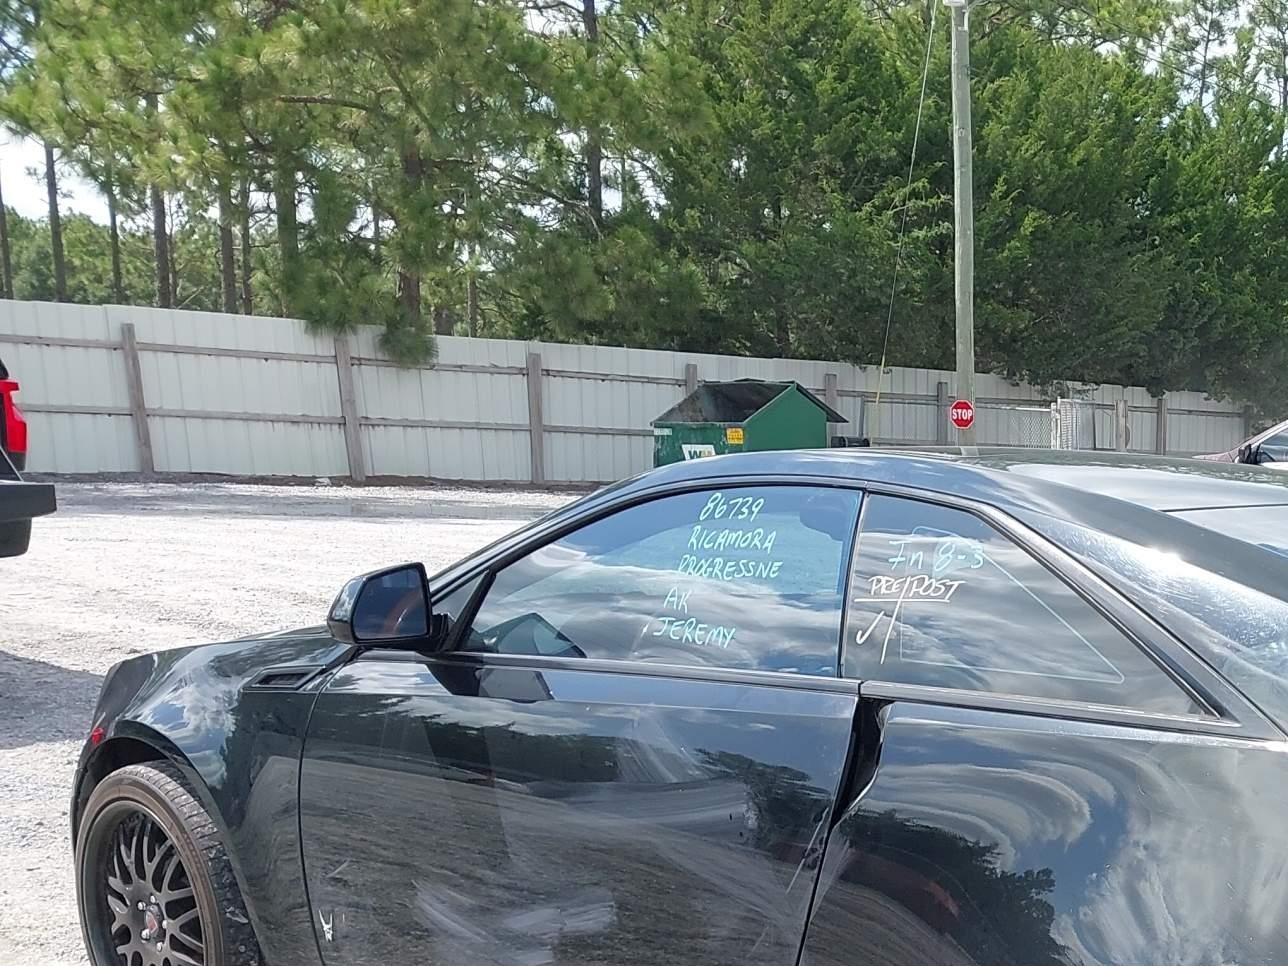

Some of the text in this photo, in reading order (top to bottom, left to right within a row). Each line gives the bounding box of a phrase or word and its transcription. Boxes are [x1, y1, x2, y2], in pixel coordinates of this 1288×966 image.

[952, 408, 973, 420] STOP
[699, 492, 765, 522] 86739
[687, 525, 777, 554] RICAMORA
[663, 586, 693, 614] AK
[652, 616, 737, 649] JEREMY
